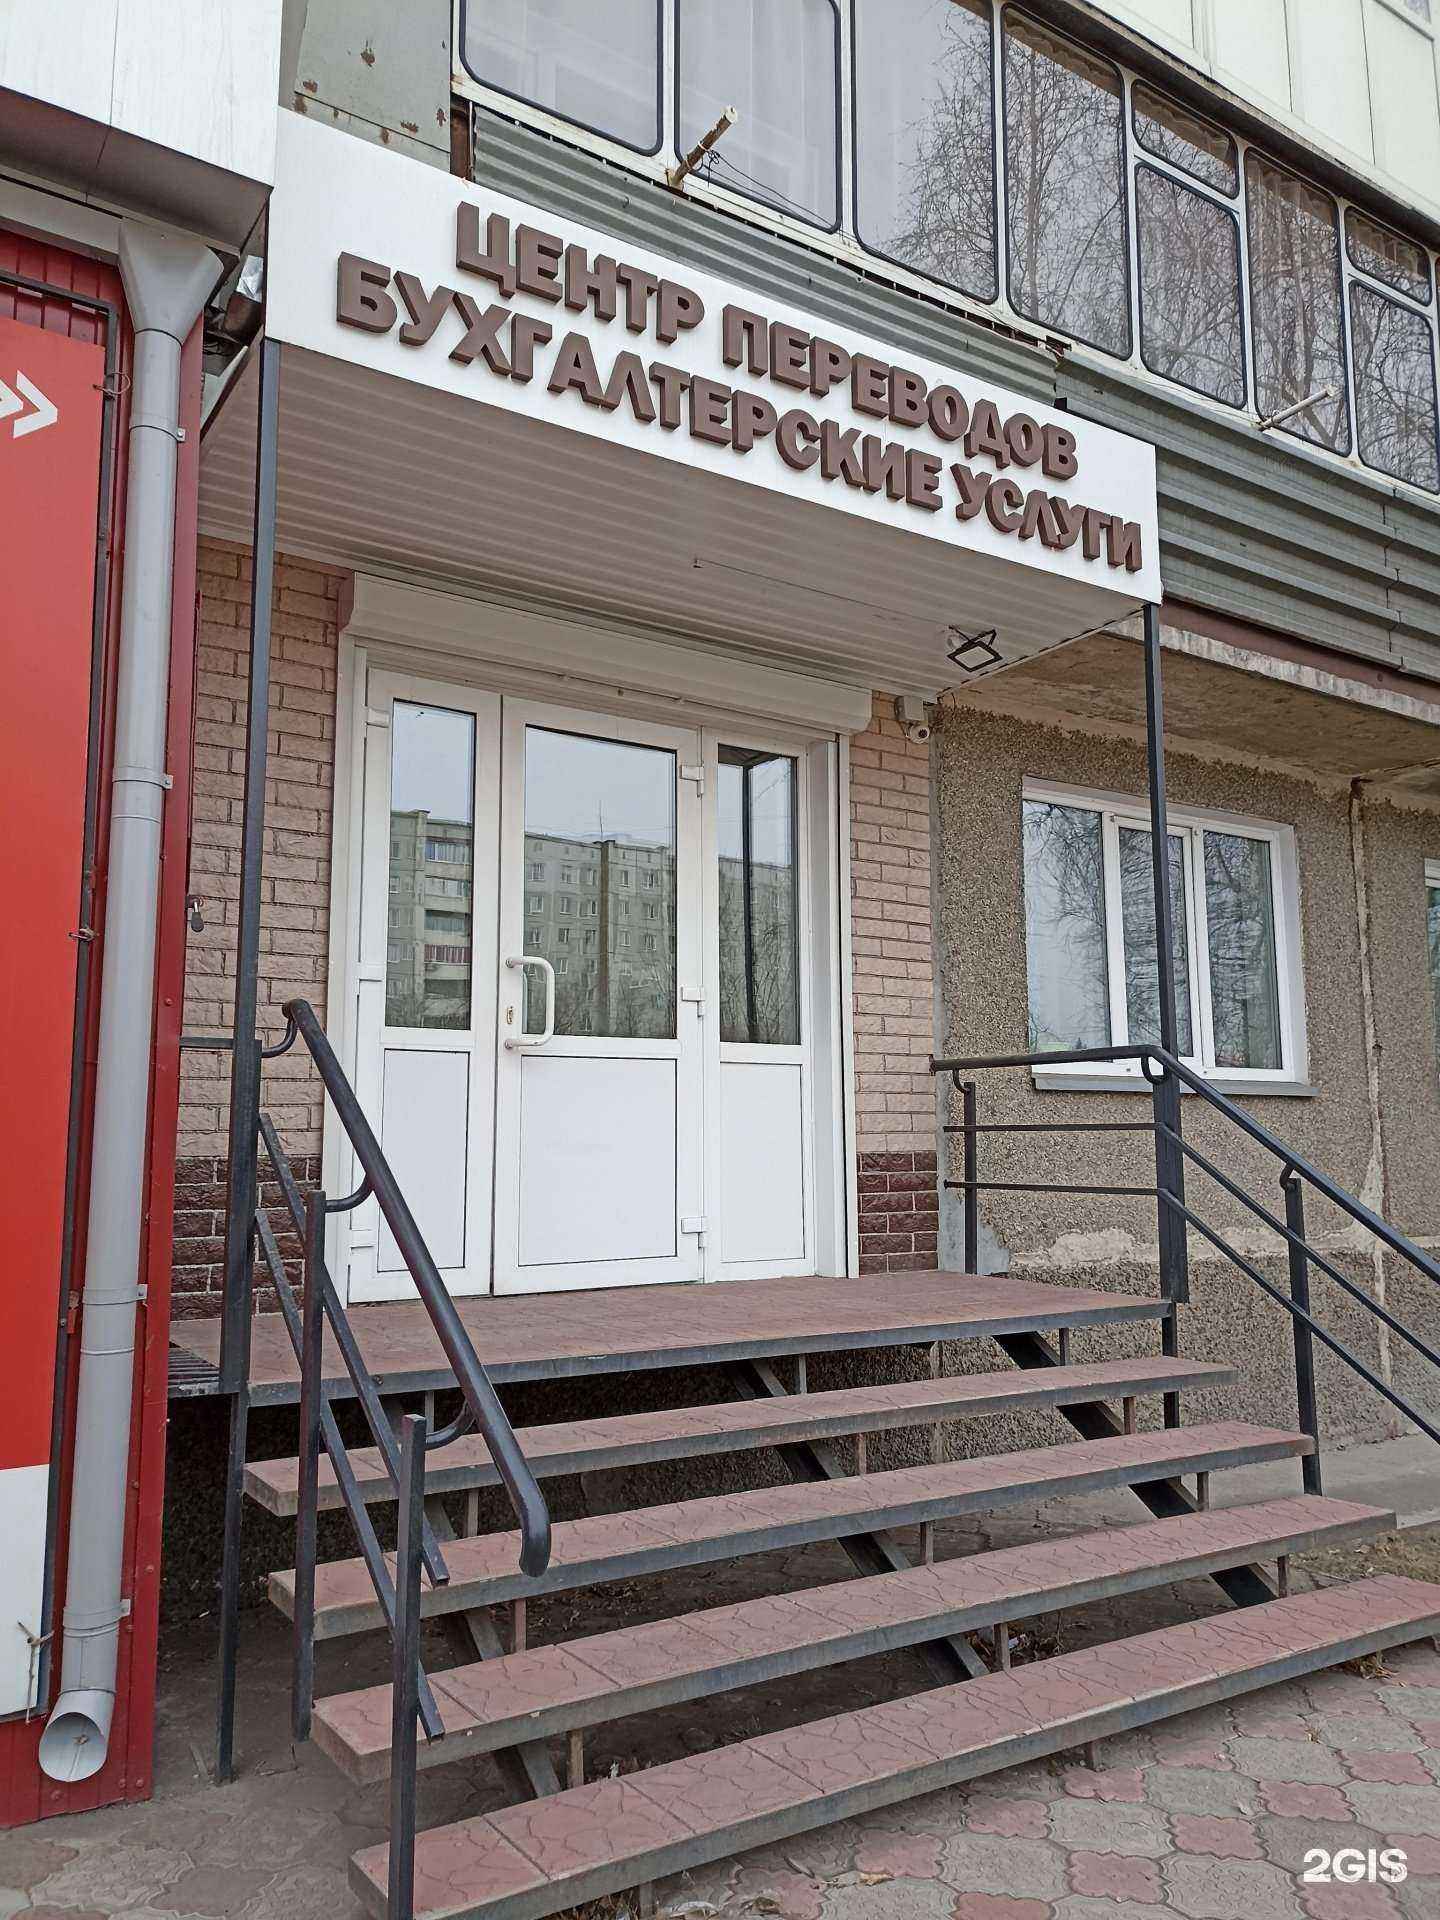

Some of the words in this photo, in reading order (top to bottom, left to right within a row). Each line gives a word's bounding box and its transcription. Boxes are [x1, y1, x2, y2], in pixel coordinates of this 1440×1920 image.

[337, 252, 943, 512] БУХГАЛТЕРСКИЕ
[951, 463, 1142, 573] УСЛУГИ
[456, 201, 704, 343] ЦЕНТР
[723, 304, 1078, 480] ПЕРЕВОДОВ
